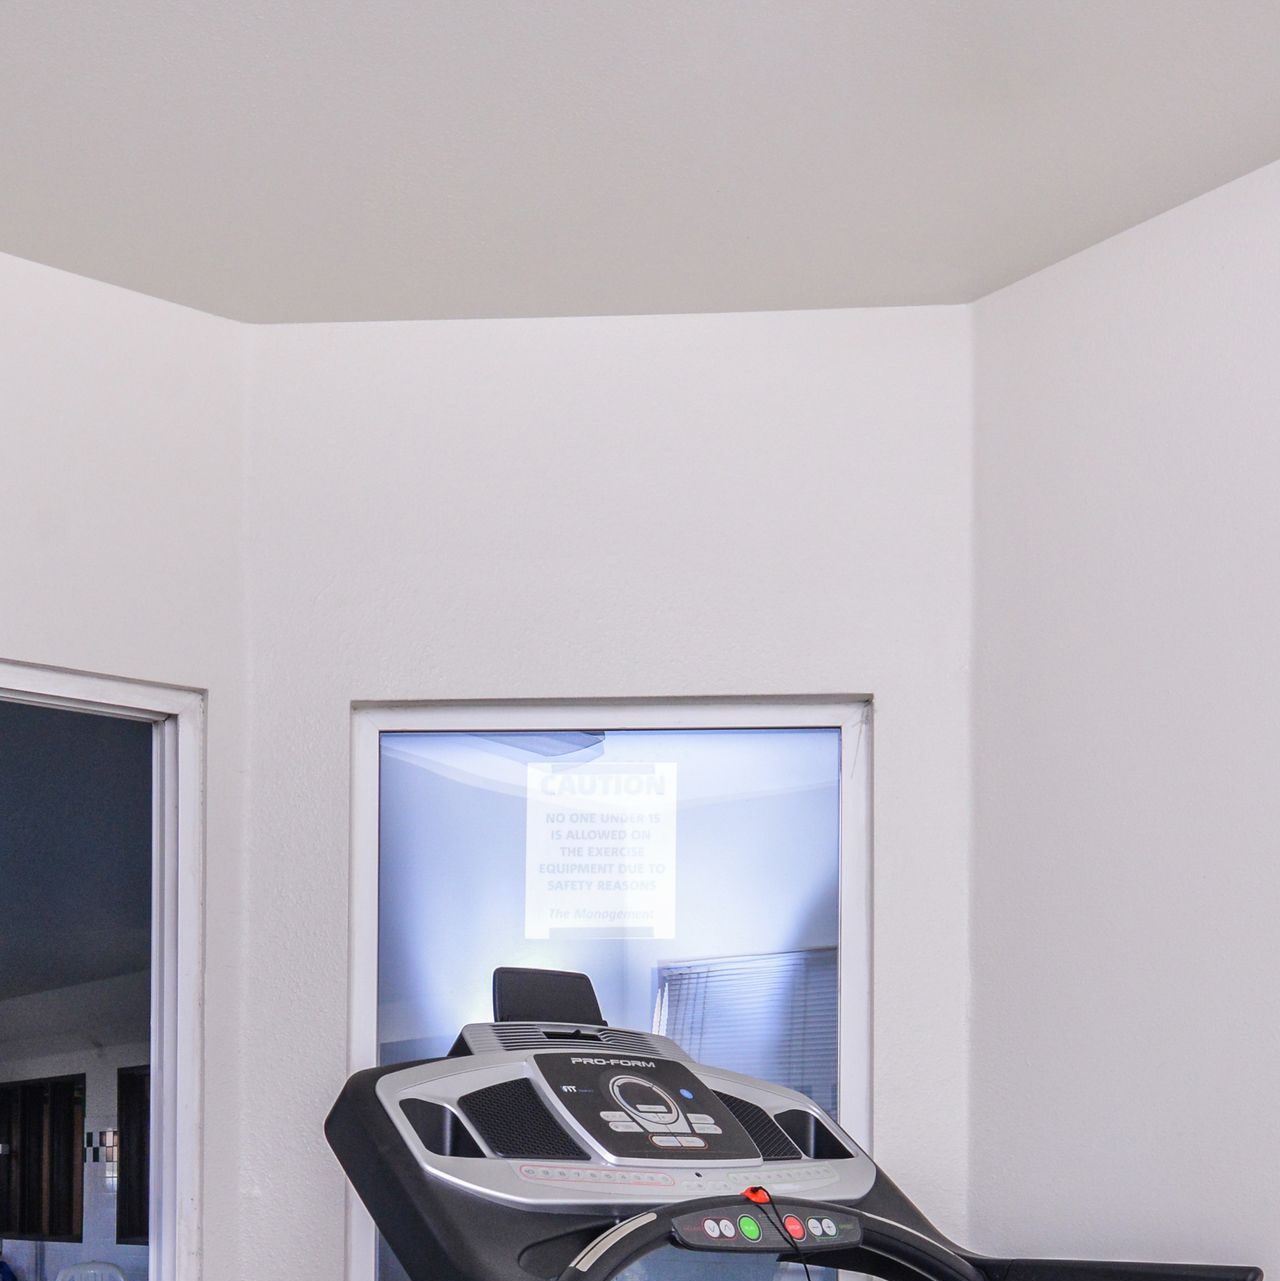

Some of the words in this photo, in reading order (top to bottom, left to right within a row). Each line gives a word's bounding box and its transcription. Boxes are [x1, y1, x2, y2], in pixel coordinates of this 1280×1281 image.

[540, 774, 666, 796] CAUTION
[546, 813, 566, 824] NO
[569, 813, 597, 824] ONE
[600, 813, 644, 824] UNDER
[551, 830, 562, 841] IS
[566, 830, 627, 841] ALLOWED
[631, 830, 651, 841] ON
[560, 846, 584, 857] THE
[588, 846, 645, 857] EXERCISE
[539, 863, 615, 875] EQUIPMENT
[619, 863, 644, 875] DUE
[649, 863, 666, 875] TO
[547, 880, 593, 892] SAFETY
[597, 880, 657, 892] REASONS
[548, 908, 570, 920] The
[574, 908, 655, 922] Management
[570, 1057, 656, 1068] PRO-FORM
